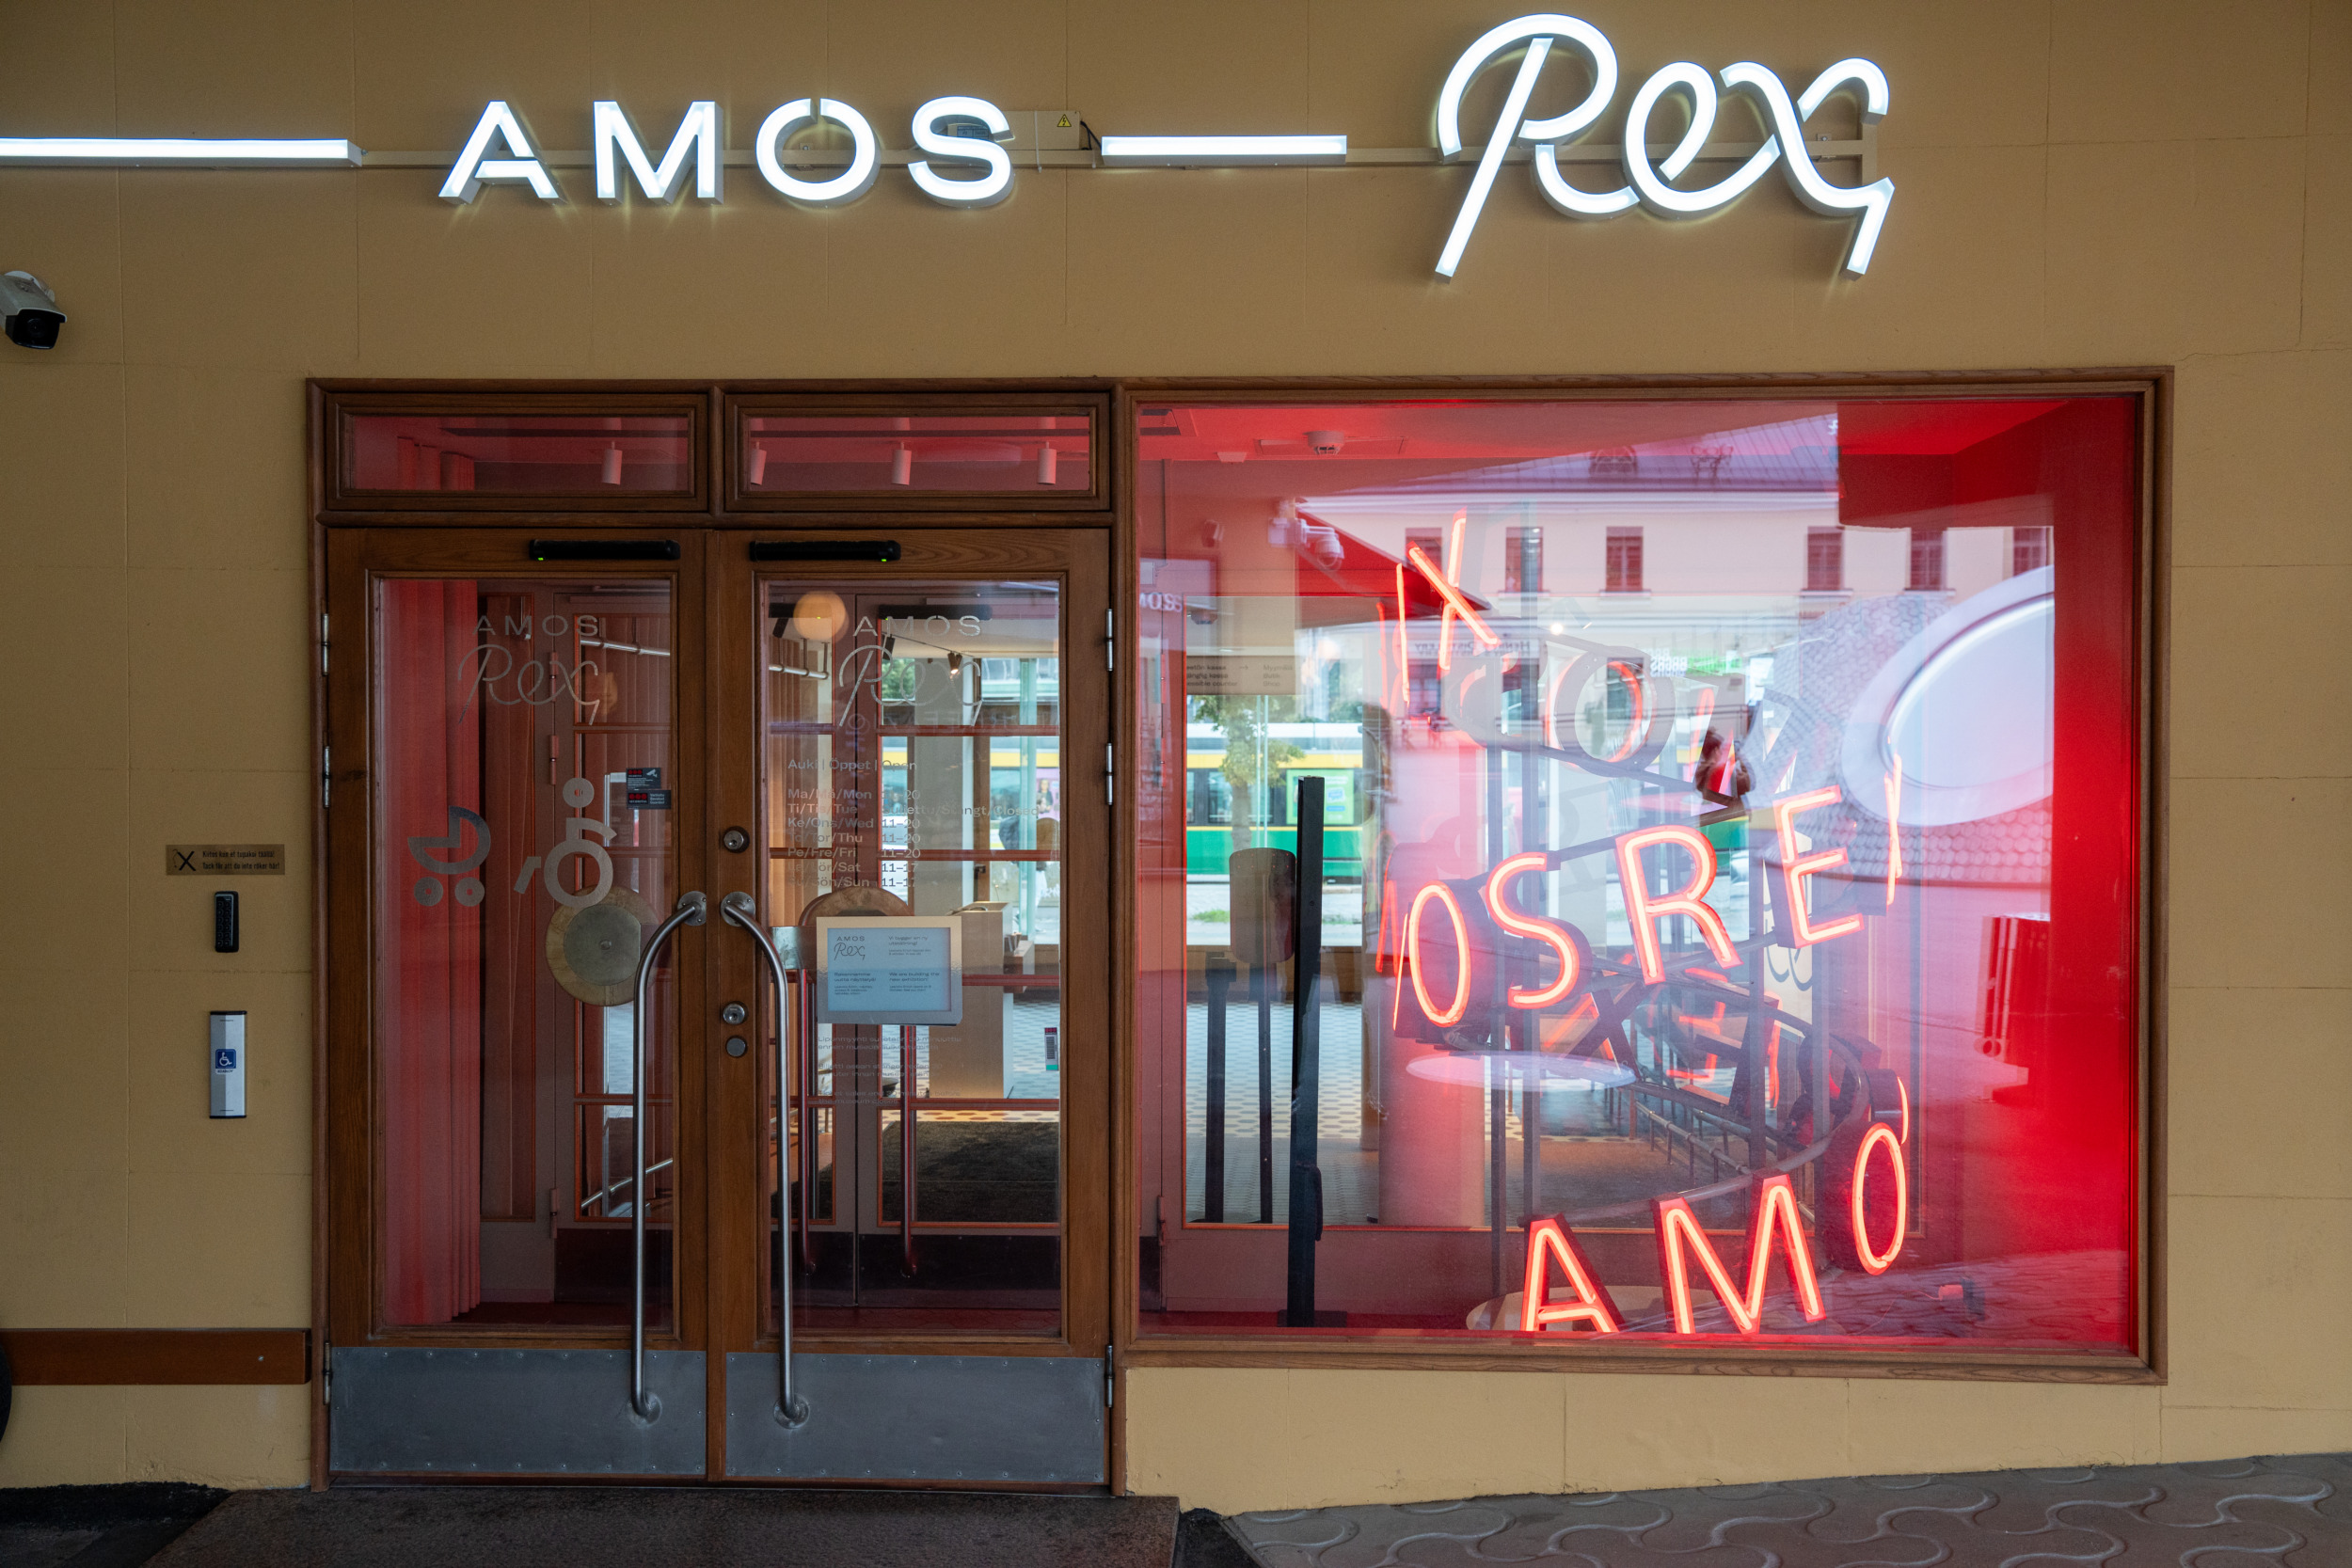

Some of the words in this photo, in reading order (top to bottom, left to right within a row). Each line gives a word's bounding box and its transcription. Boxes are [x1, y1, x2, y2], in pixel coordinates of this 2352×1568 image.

[438, 95, 1014, 207] AMOS
[1434, 11, 1896, 279] Rex
[472, 614, 599, 637] AMOS
[852, 614, 982, 637] AMOS
[457, 644, 600, 726] Rex
[838, 644, 983, 727] Rex
[787, 758, 818, 769] Auki
[829, 757, 871, 772] Öppet
[882, 759, 917, 772] Open
[787, 817, 875, 830] Ke/Ons/Wed
[787, 847, 857, 859] Pe/Fre/Fri
[834, 942, 866, 961] Rex
